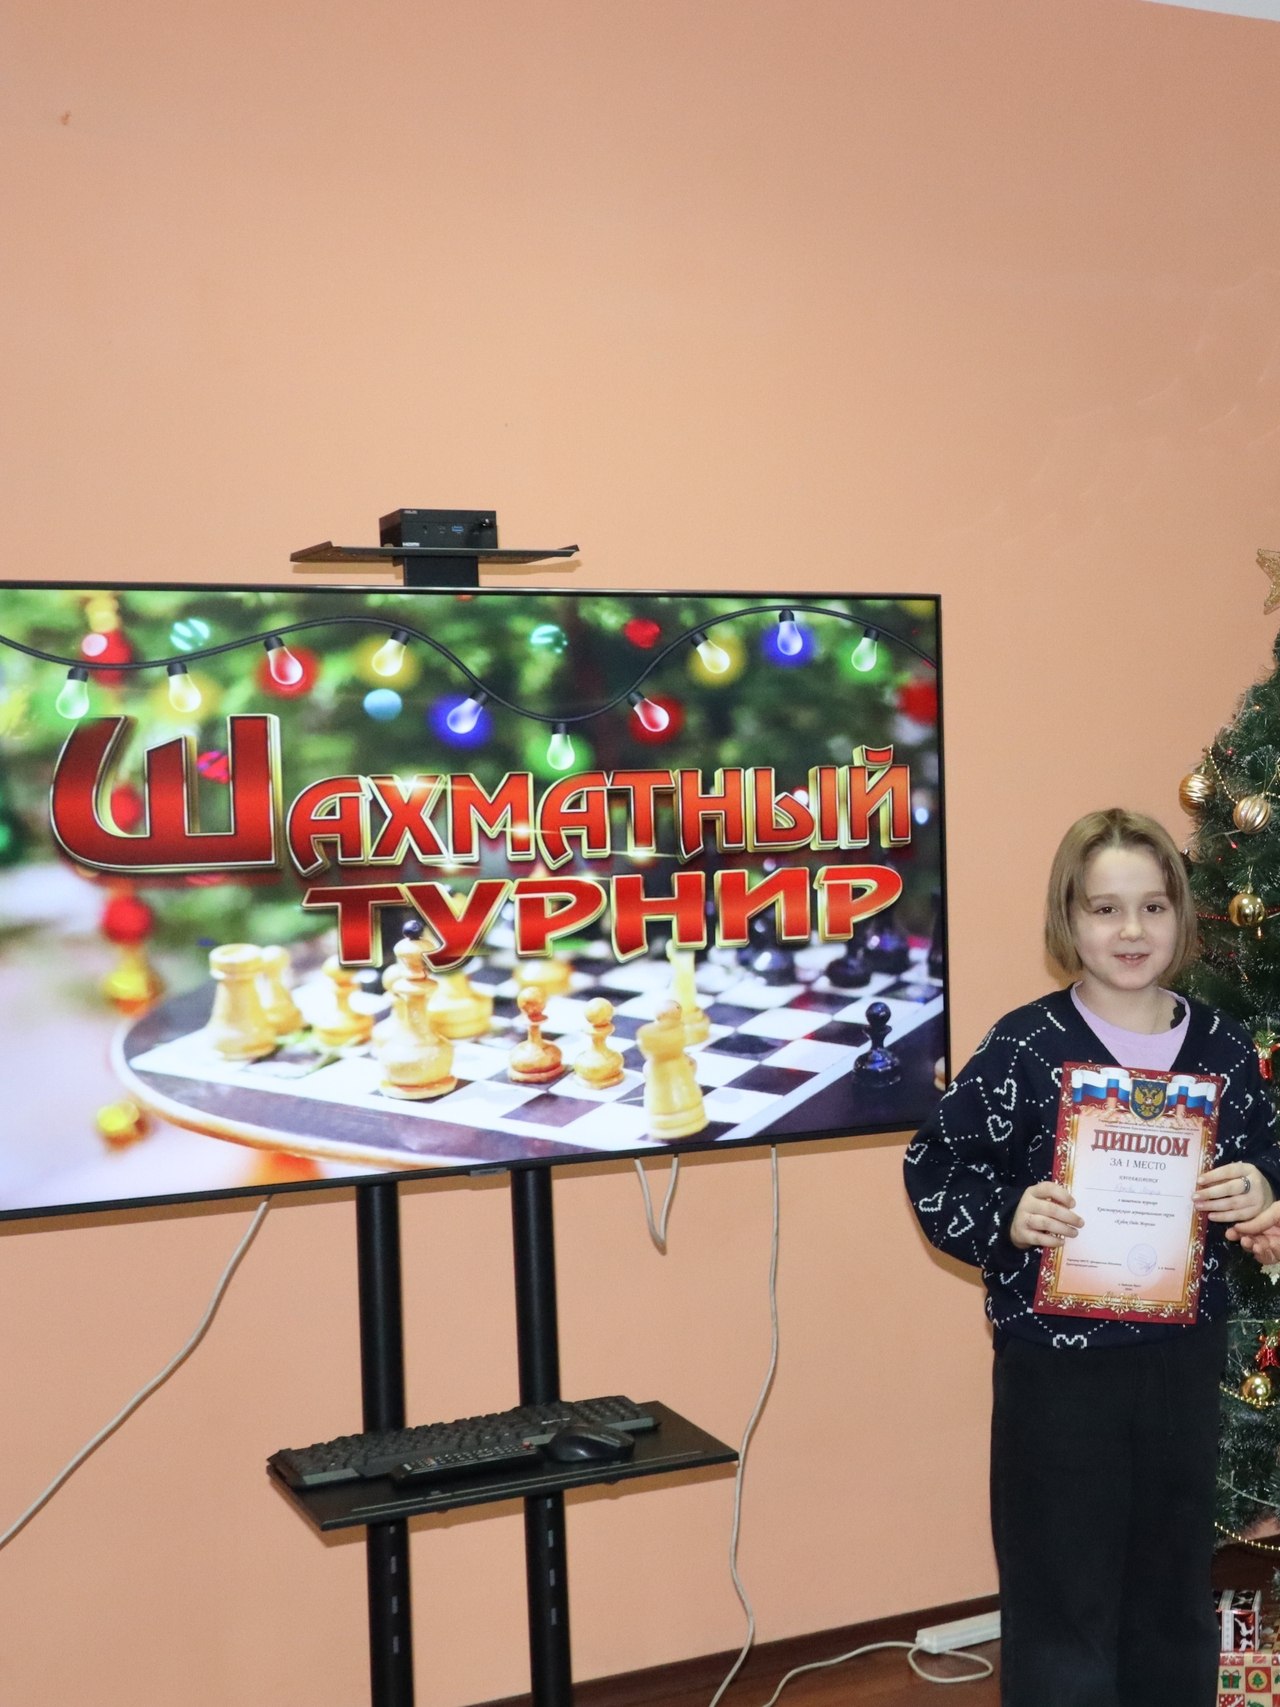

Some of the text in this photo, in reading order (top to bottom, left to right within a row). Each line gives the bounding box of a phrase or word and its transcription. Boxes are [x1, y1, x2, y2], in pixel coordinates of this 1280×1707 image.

[50, 713, 914, 878] ШАХМАТНЫЙ
[301, 864, 905, 973] ТУРНИР
[1091, 1129, 1190, 1157] ДИПЛОМ
[1110, 1158, 1122, 1167] ЗА
[1132, 1161, 1167, 1171] МЕСТО
